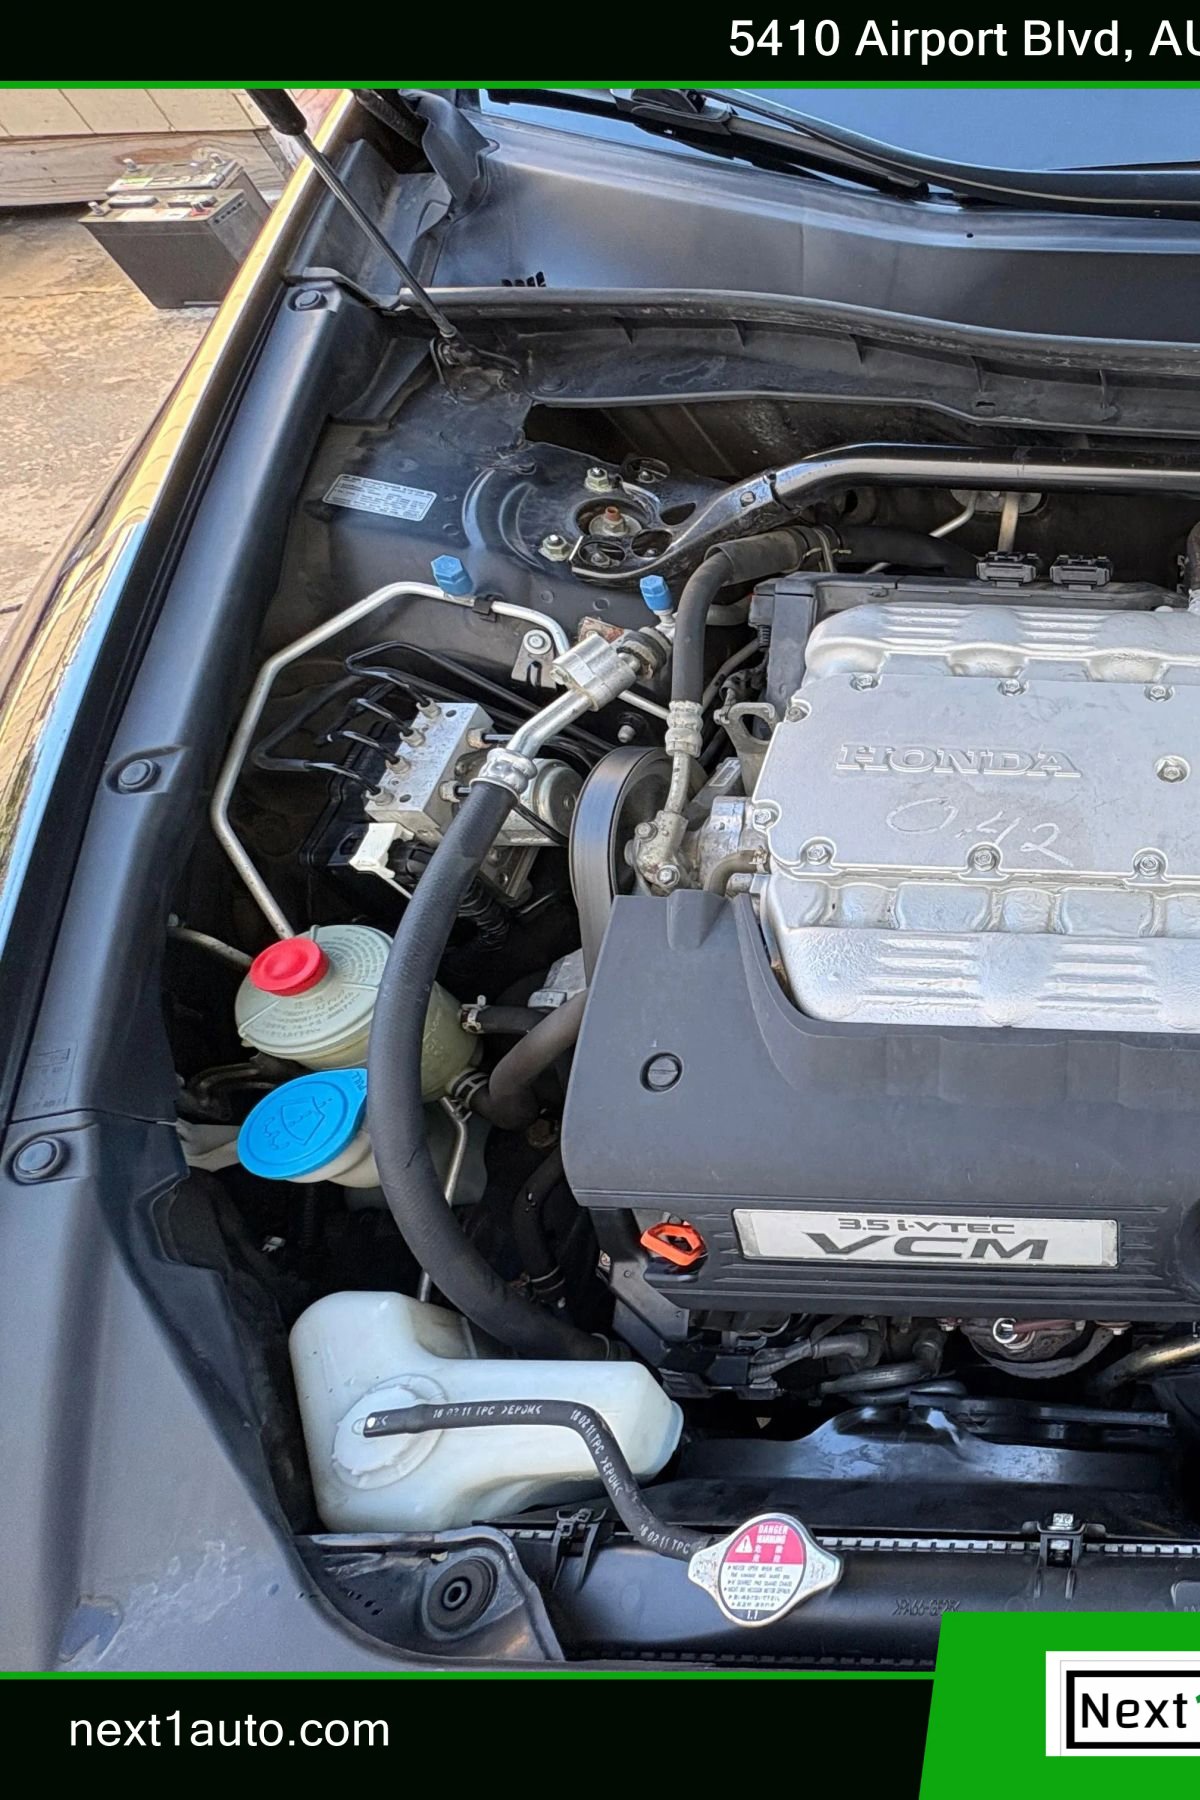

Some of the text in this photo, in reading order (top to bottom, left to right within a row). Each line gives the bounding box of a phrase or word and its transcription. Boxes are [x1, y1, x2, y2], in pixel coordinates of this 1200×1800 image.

[836, 744, 1082, 778] HONDA
[838, 1218, 1015, 1235] 3.5 i-VTEC
[801, 1231, 1049, 1260] VCM
[590, 1432, 605, 1456] TPC
[758, 1524, 789, 1535] DANGER
[672, 1538, 691, 1555] TPC
